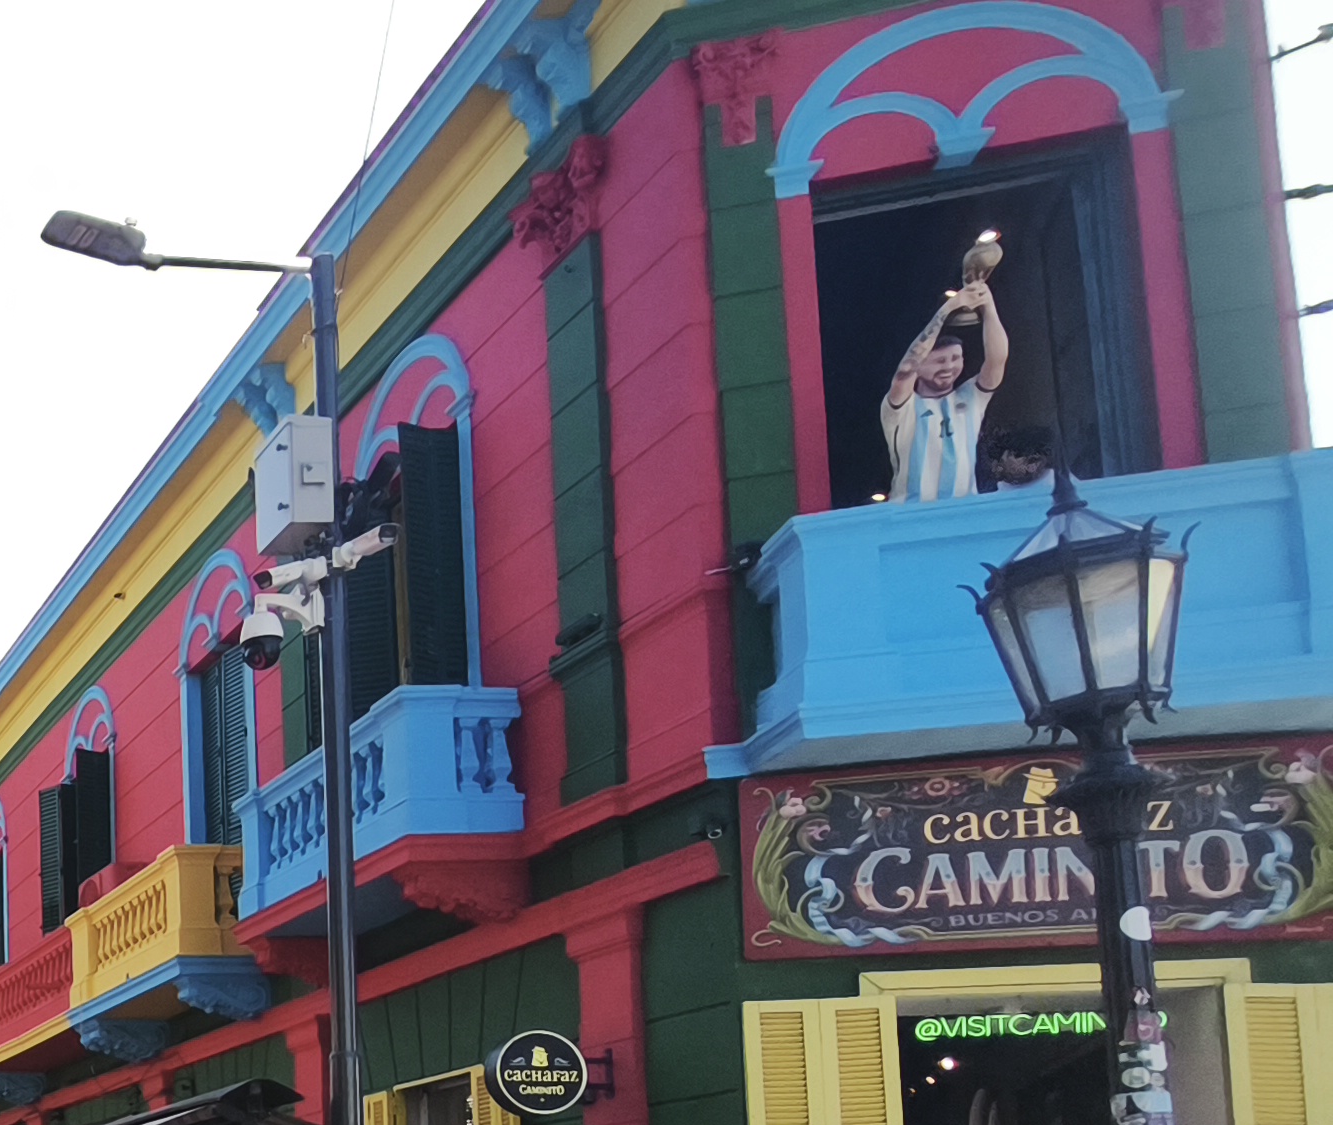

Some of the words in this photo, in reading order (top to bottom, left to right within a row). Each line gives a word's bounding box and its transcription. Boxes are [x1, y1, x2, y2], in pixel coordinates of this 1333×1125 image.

[923, 801, 1174, 845] cacHaz
[854, 828, 1250, 913] CAMINTO
[949, 908, 1059, 928] BUENOS
[915, 1010, 1168, 1042] @VISITCAMIN
[518, 1084, 566, 1096] CAMINITO
